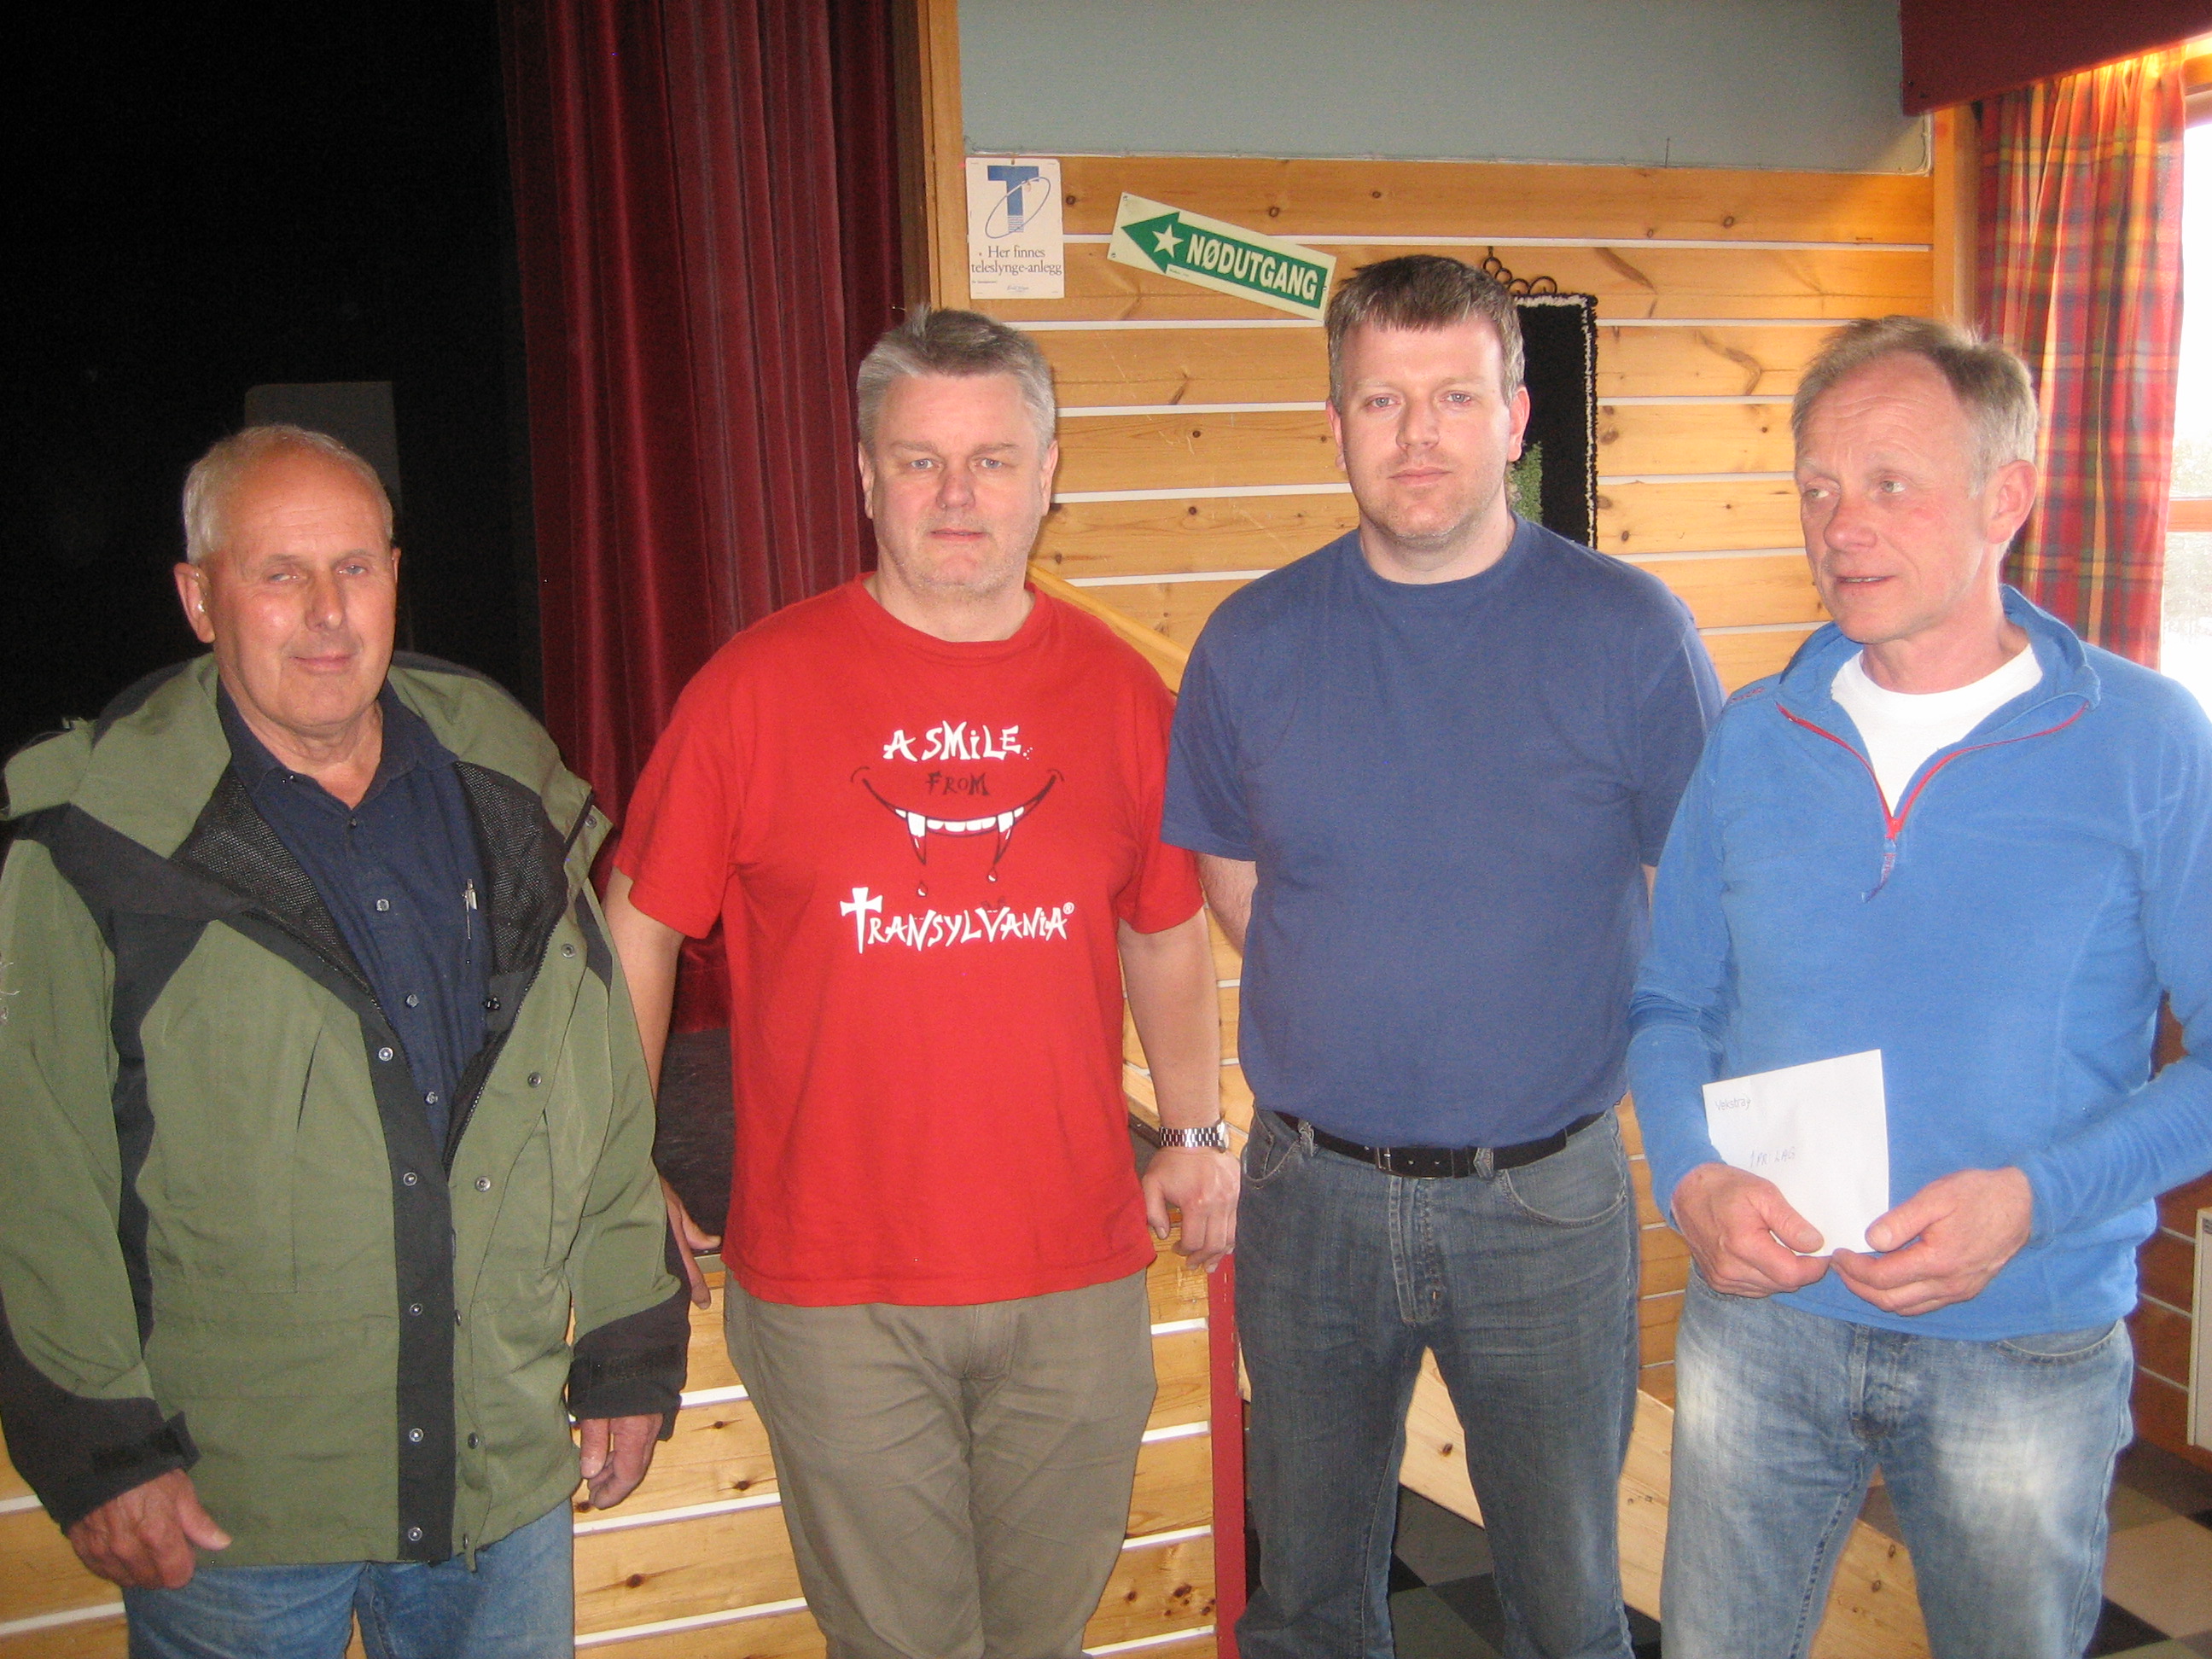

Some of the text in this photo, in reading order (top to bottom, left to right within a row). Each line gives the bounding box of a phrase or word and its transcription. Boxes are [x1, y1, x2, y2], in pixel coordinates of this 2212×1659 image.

[988, 245, 1046, 259] Her finnes
[971, 260, 1062, 276] teleslynge-anlegg
[1185, 233, 1318, 301] NØDUTGANG
[882, 730, 918, 762] A
[926, 771, 991, 796] FROM
